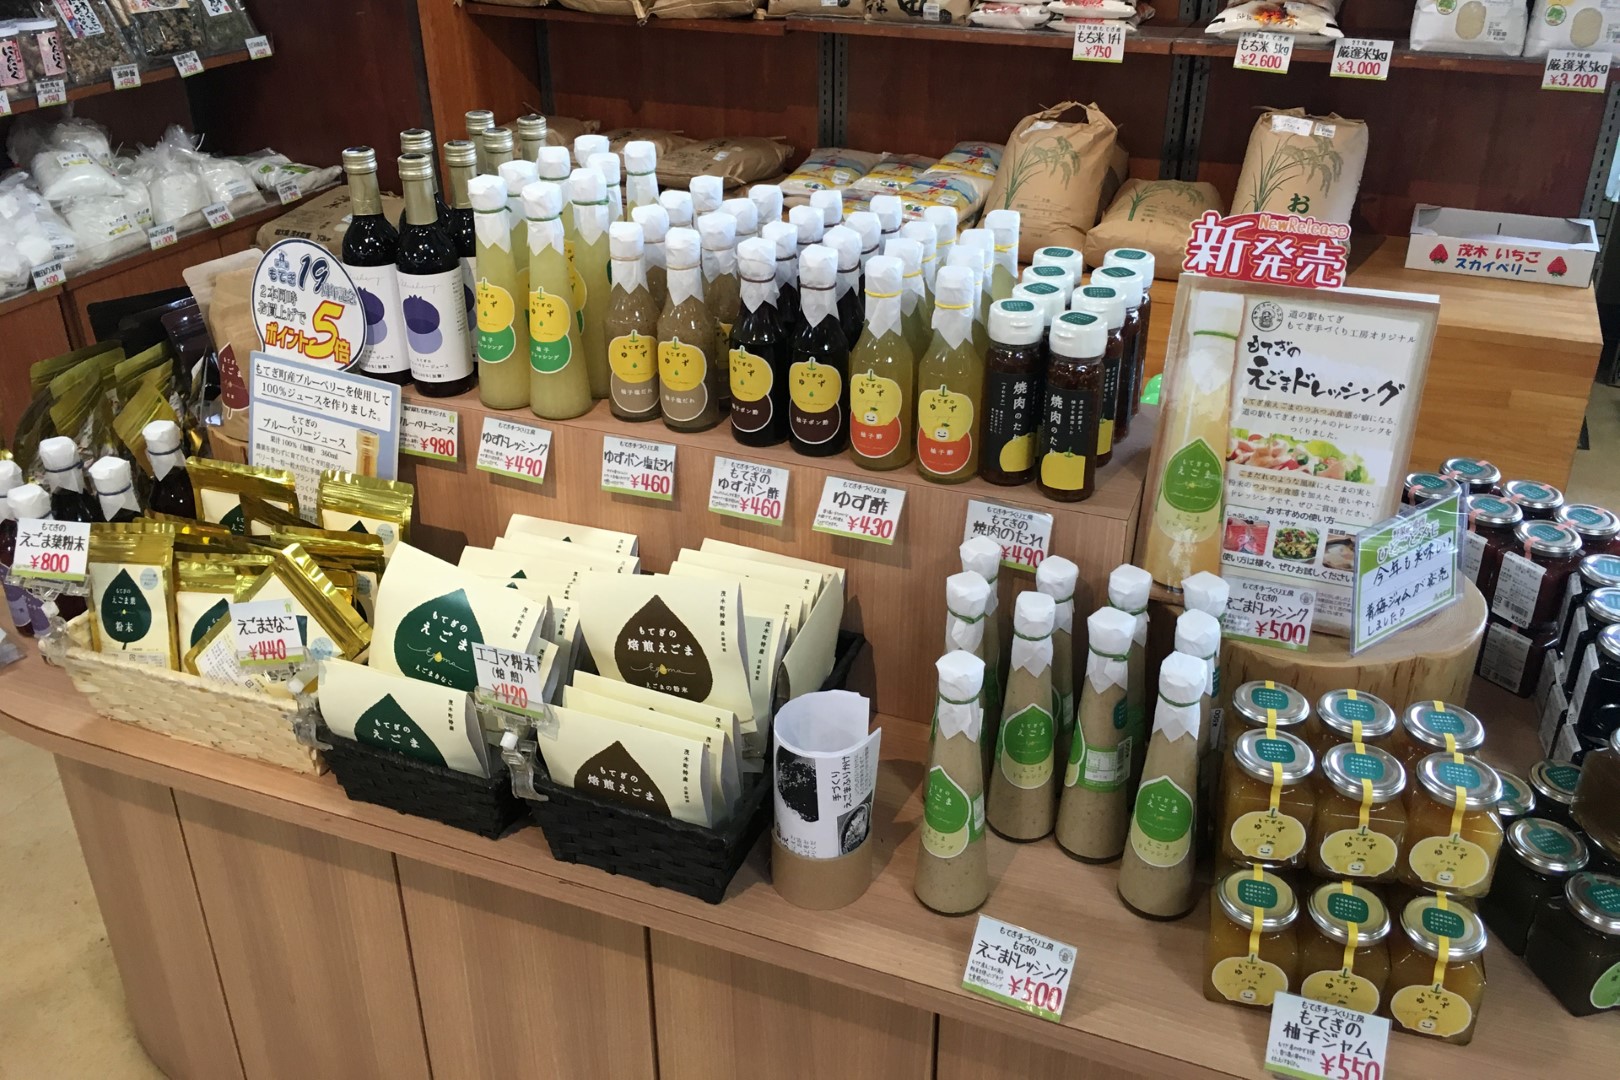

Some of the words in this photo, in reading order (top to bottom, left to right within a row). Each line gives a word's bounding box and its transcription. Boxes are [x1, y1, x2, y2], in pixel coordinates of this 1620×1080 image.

[1077, 32, 1104, 44] もち米
[1241, 39, 1269, 53] もち米
[1273, 44, 1290, 55] 5kg
[2, 45, 20, 80] にんにく
[47, 36, 63, 70] にんにく
[1085, 46, 1112, 58] ¥750
[1187, 215, 1342, 286] 新発売
[1457, 244, 1489, 259] 茂木
[1496, 248, 1541, 264] いちご
[267, 267, 298, 288] もてぎ
[298, 254, 331, 294] 19
[1455, 258, 1537, 275] スカイベリー
[1288, 309, 1344, 323] 道の駅もてぎ
[1287, 321, 1417, 344] もてぎ手づくり工房オリジナル
[1247, 335, 1301, 358] もてぎの
[255, 363, 391, 407] もてぎ町産ブルーベリーを使用して
[1247, 355, 1406, 407] えごまドレッシング
[263, 418, 347, 448] ブルーベリージュース
[291, 415, 318, 429] もてぎの
[1242, 408, 1393, 436] 道の駅もてぎオリジナルのドレッシングを
[482, 432, 548, 456] ゆずドレッシング
[1290, 427, 1339, 440] つくりました。
[420, 437, 455, 457] ¥980
[505, 455, 543, 477] ¥490
[604, 450, 673, 473] ゆずポン塩だれ
[630, 473, 670, 495] ¥460
[730, 468, 771, 485] もてぎの
[718, 477, 780, 500] ゆずポン酢
[739, 496, 781, 520] ¥460
[832, 490, 890, 516] ゆず酢
[992, 514, 1028, 531] もてぎの
[1266, 506, 1336, 525] おすすめの使い方
[42, 522, 67, 532] もてぎの
[847, 515, 893, 539] ¥430
[973, 520, 1044, 548] 焼肉のたれ
[19, 531, 86, 552] えごま葉粉末
[30, 552, 70, 574] ¥800
[1001, 545, 1044, 569] ¥490
[1256, 592, 1277, 602] もてぎの
[1227, 597, 1309, 623] えごまドレッシング
[115, 621, 134, 633] 粉末
[237, 616, 295, 635] えごまきなこ
[432, 611, 468, 633] もてぎの
[639, 626, 677, 638] もてぎの
[1255, 619, 1306, 644] ¥500
[420, 621, 468, 652] えごま
[627, 638, 694, 657] 焙煎えごま
[249, 639, 287, 660] ¥440
[475, 646, 536, 675] エゴマ粉末
[415, 664, 453, 686] えごまきなこ
[491, 667, 523, 685] (焙煎)
[491, 683, 528, 709] ¥420
[645, 682, 689, 694] えごまの粉末
[375, 719, 411, 734] もてぎの
[373, 729, 420, 749] えごま
[600, 766, 639, 783] もてぎの
[587, 773, 655, 803] 焙煎えごま
[1000, 926, 1054, 952] もてぎ手づくり工房
[1013, 941, 1037, 956] もてぎの
[976, 940, 1068, 985] えごまドレッシング
[1008, 976, 1062, 1012] ¥500
[1301, 1001, 1364, 1023] もてぎ手づくり工房
[1300, 1010, 1361, 1038] もてぎの
[1283, 1021, 1373, 1059] 柚子ジャム
[1320, 1053, 1380, 1080] ¥550
